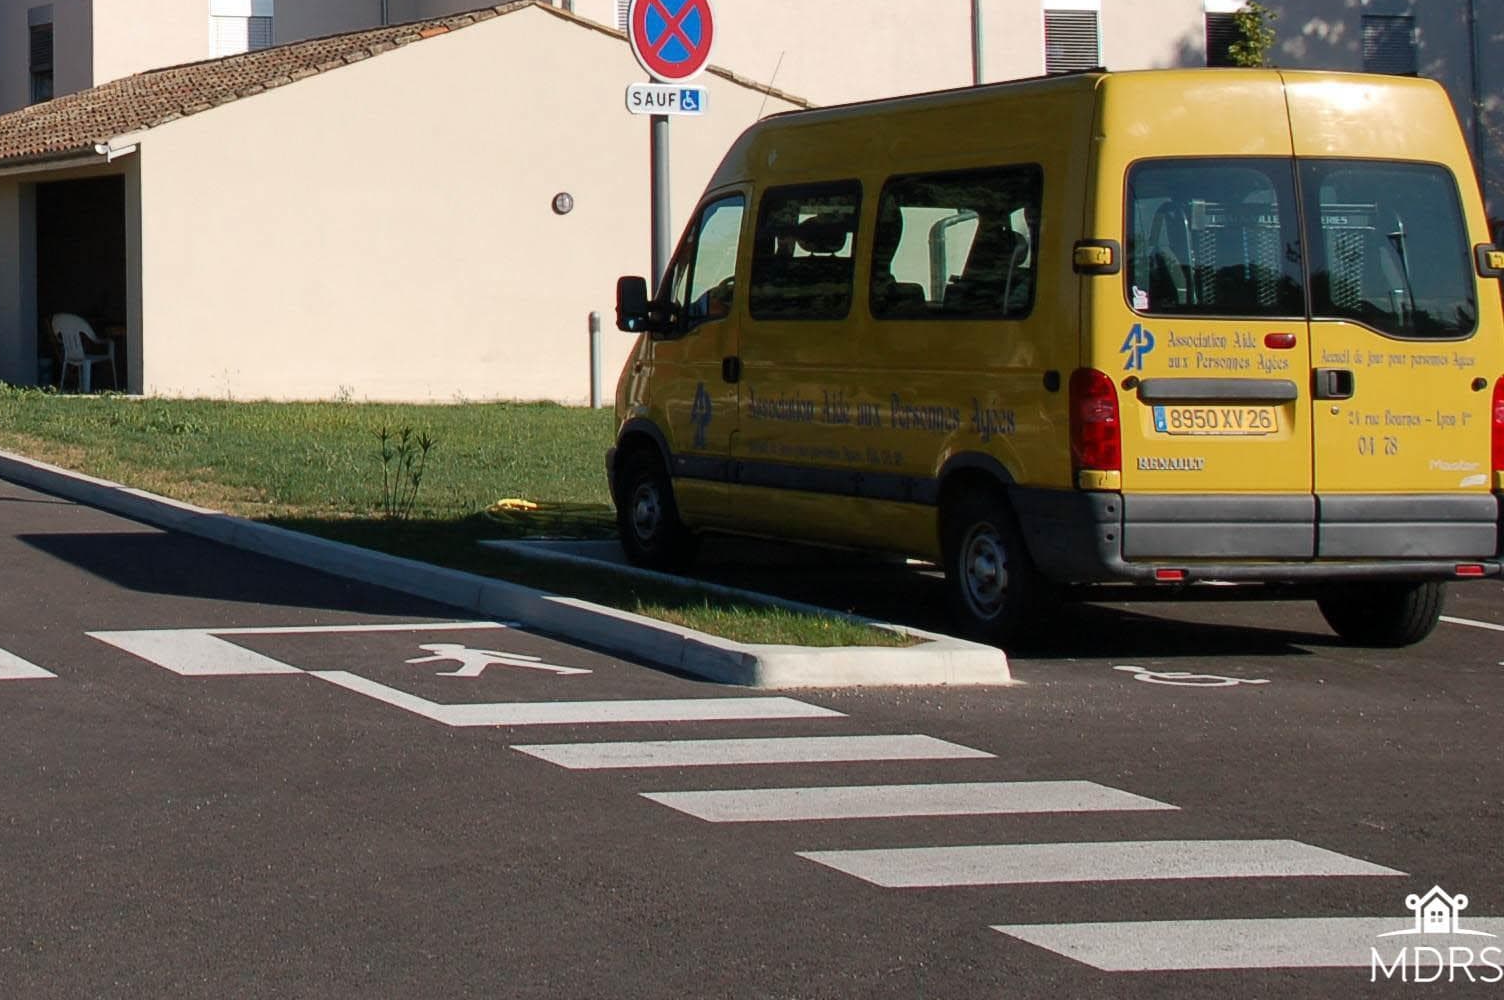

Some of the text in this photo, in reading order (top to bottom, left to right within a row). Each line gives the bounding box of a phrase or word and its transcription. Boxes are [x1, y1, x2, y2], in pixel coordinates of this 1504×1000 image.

[632, 91, 677, 107] SAUF
[1167, 329, 1257, 349] Association Aide
[1167, 355, 1189, 369] aux
[1195, 350, 1251, 370] Personnes
[1170, 408, 1272, 429] 8950 XV 26
[1137, 457, 1206, 471] RENAULT
